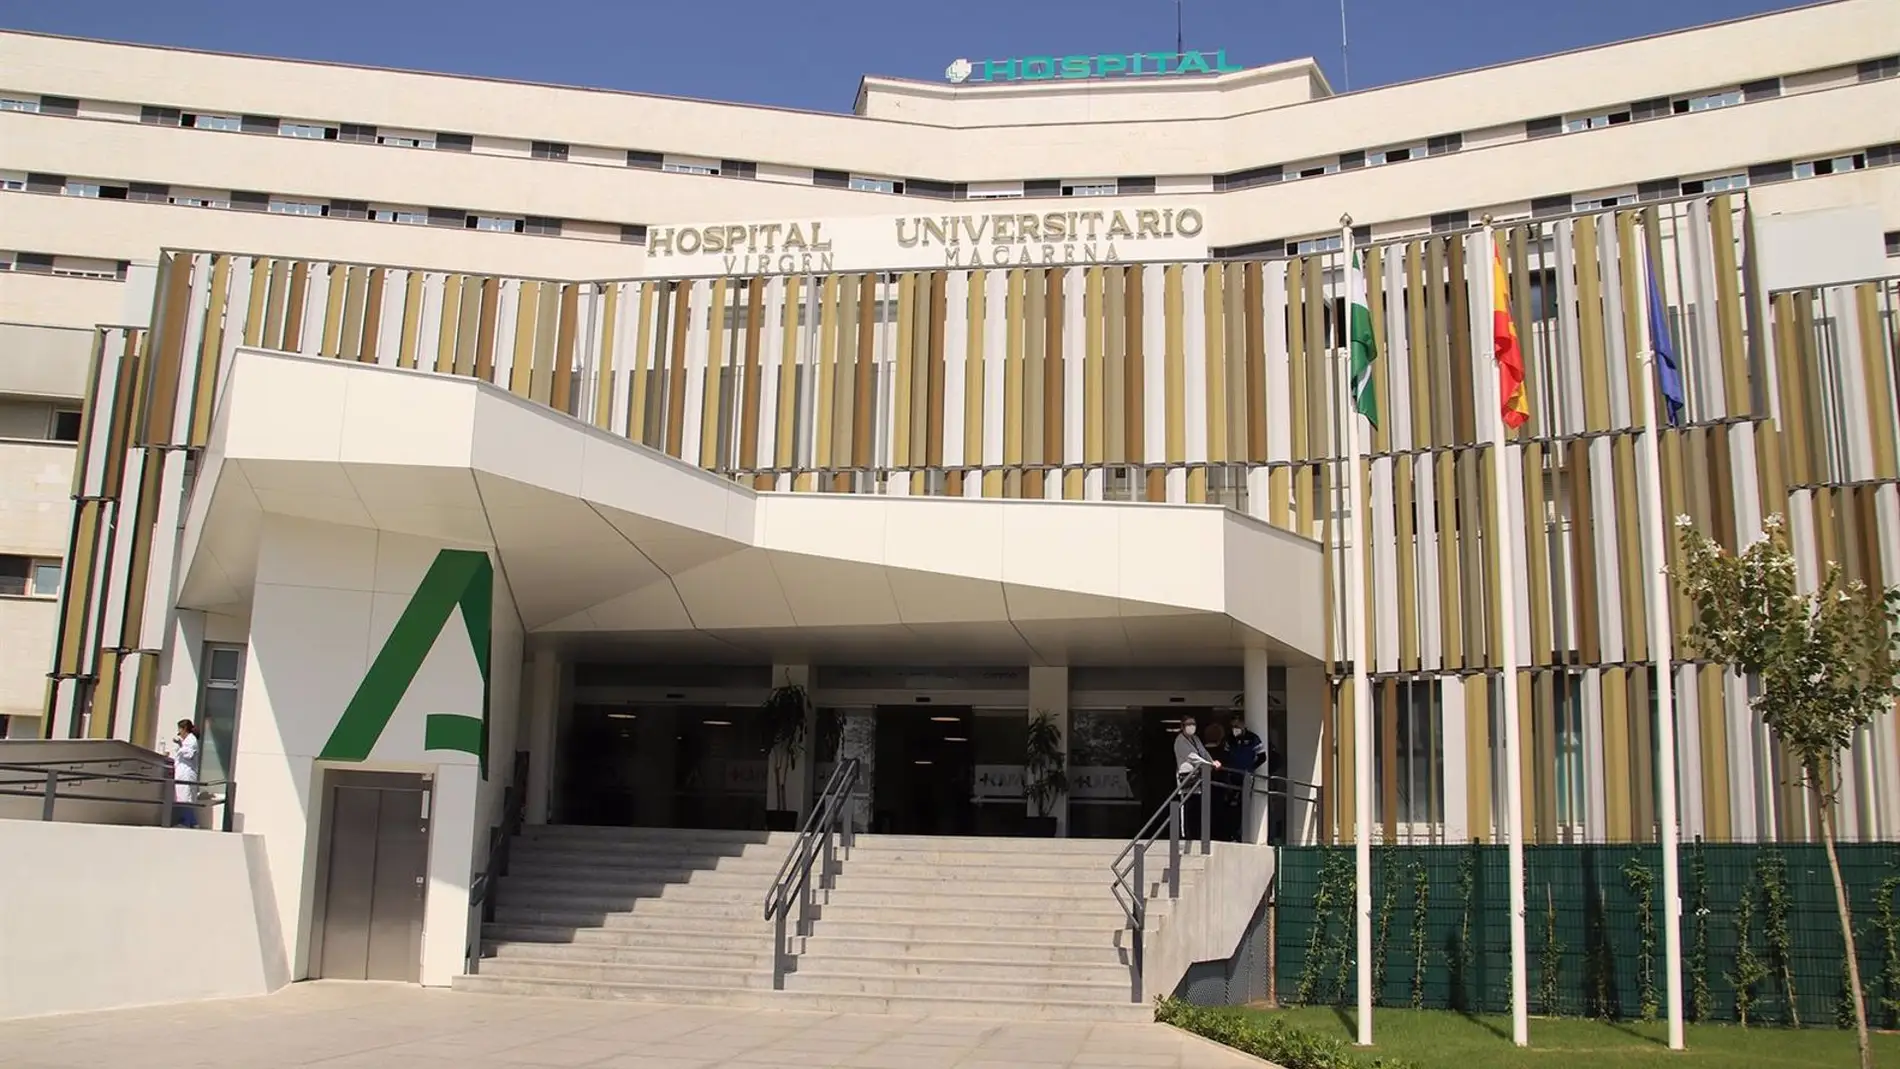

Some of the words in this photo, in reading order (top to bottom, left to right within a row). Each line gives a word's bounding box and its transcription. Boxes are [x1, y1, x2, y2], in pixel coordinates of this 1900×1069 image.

[984, 47, 1244, 82] HOSPITAL
[647, 221, 832, 257] HOSPITAL
[895, 207, 1204, 248] UNIVERSITARIO
[723, 251, 835, 275] VIRGEN
[945, 242, 1121, 267] MACARENA
